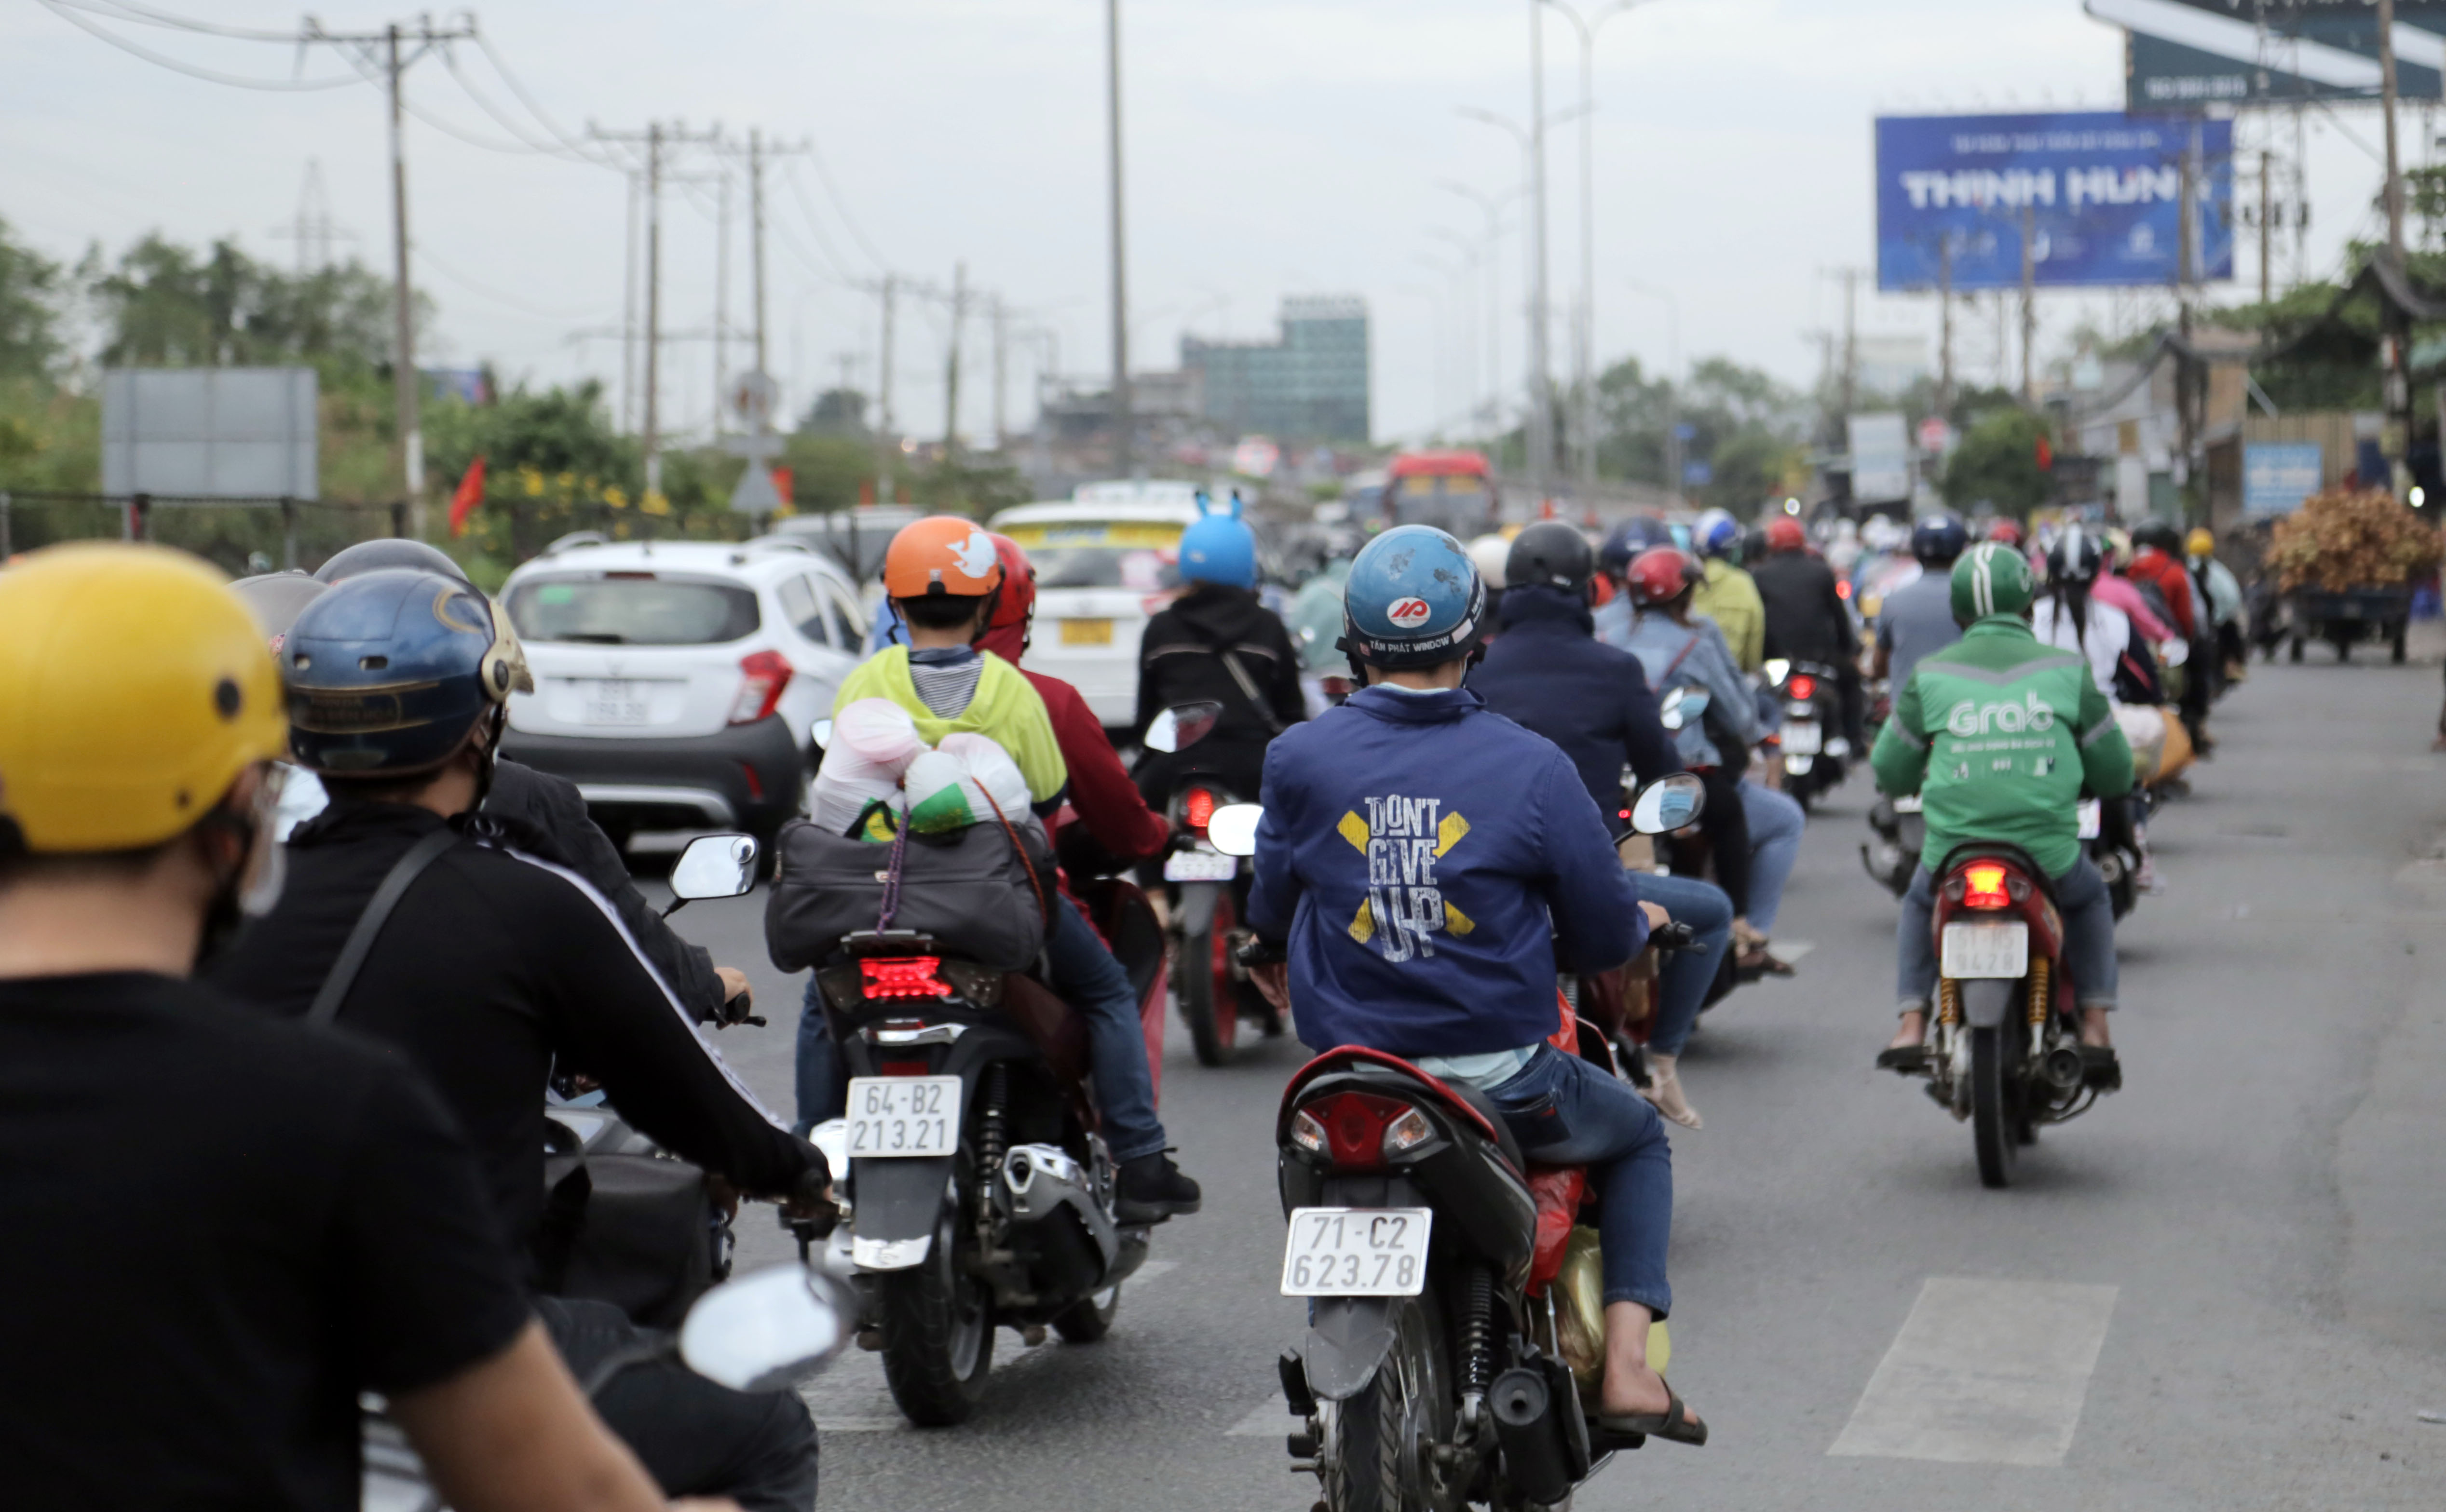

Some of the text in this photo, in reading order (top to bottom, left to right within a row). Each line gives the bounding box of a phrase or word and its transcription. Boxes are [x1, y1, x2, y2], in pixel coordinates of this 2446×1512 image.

[1413, 635, 1450, 652] WINDOW
[1948, 689, 2054, 737] Grab
[1364, 794, 1441, 837] DON'T
[1368, 838, 1438, 886] GIVE
[1369, 887, 1444, 963] UP
[866, 1084, 942, 1115] 64-B2
[853, 1118, 946, 1151] 213.21
[1311, 1216, 1408, 1250] 71-C2
[1293, 1254, 1416, 1288] 623.78
